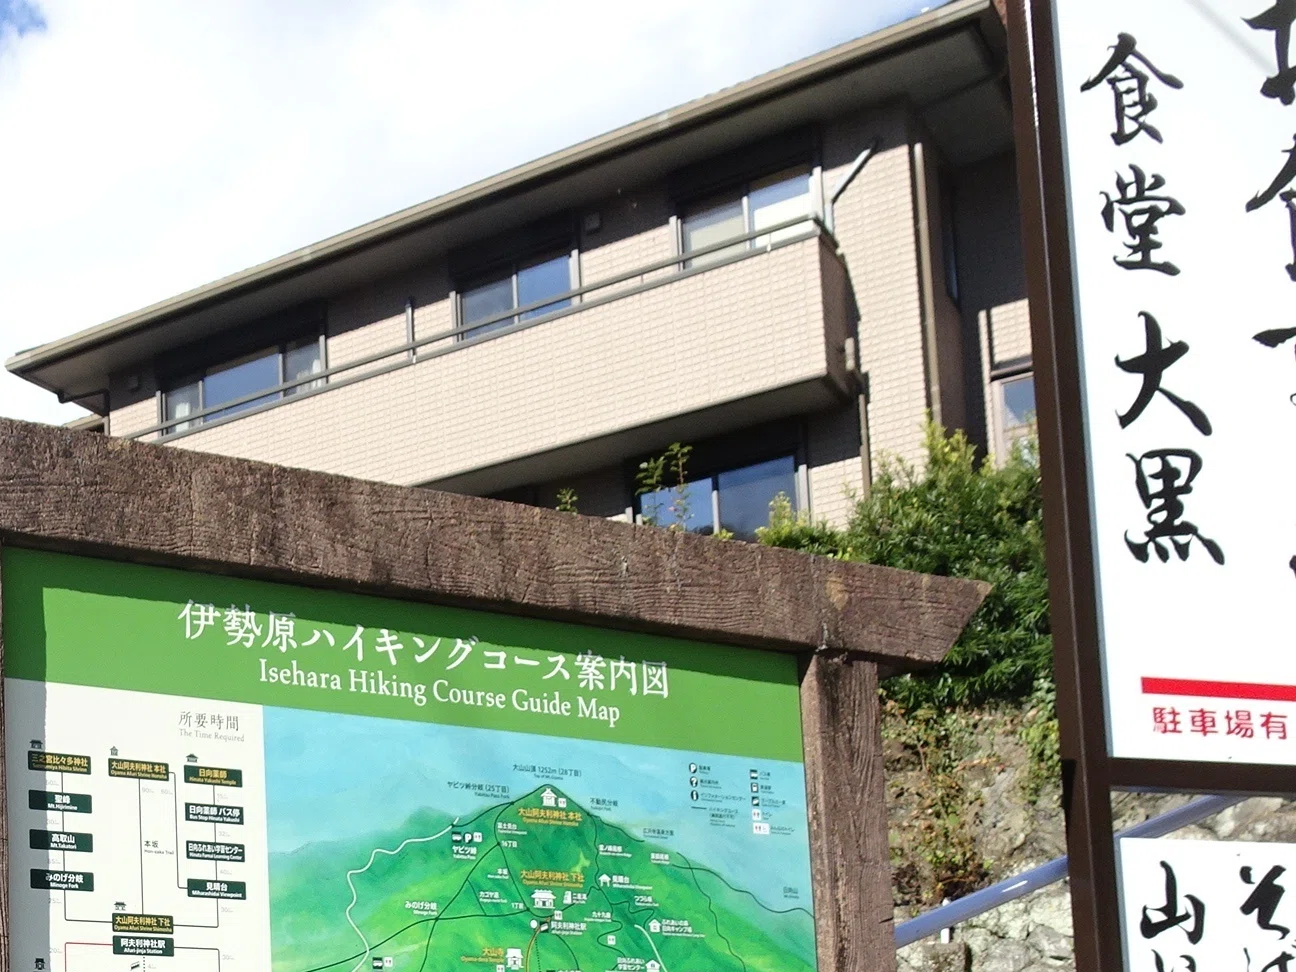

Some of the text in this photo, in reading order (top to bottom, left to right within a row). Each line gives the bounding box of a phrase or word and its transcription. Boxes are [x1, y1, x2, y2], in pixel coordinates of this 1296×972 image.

[177, 599, 669, 698] 伊勢原ハイキングコース案内図
[259, 658, 620, 727] Isehara Hiking Course Guide Map
[179, 711, 239, 731] 所要時間
[179, 728, 245, 742] The Time Required
[120, 938, 166, 949] 阿夫利神社駅
